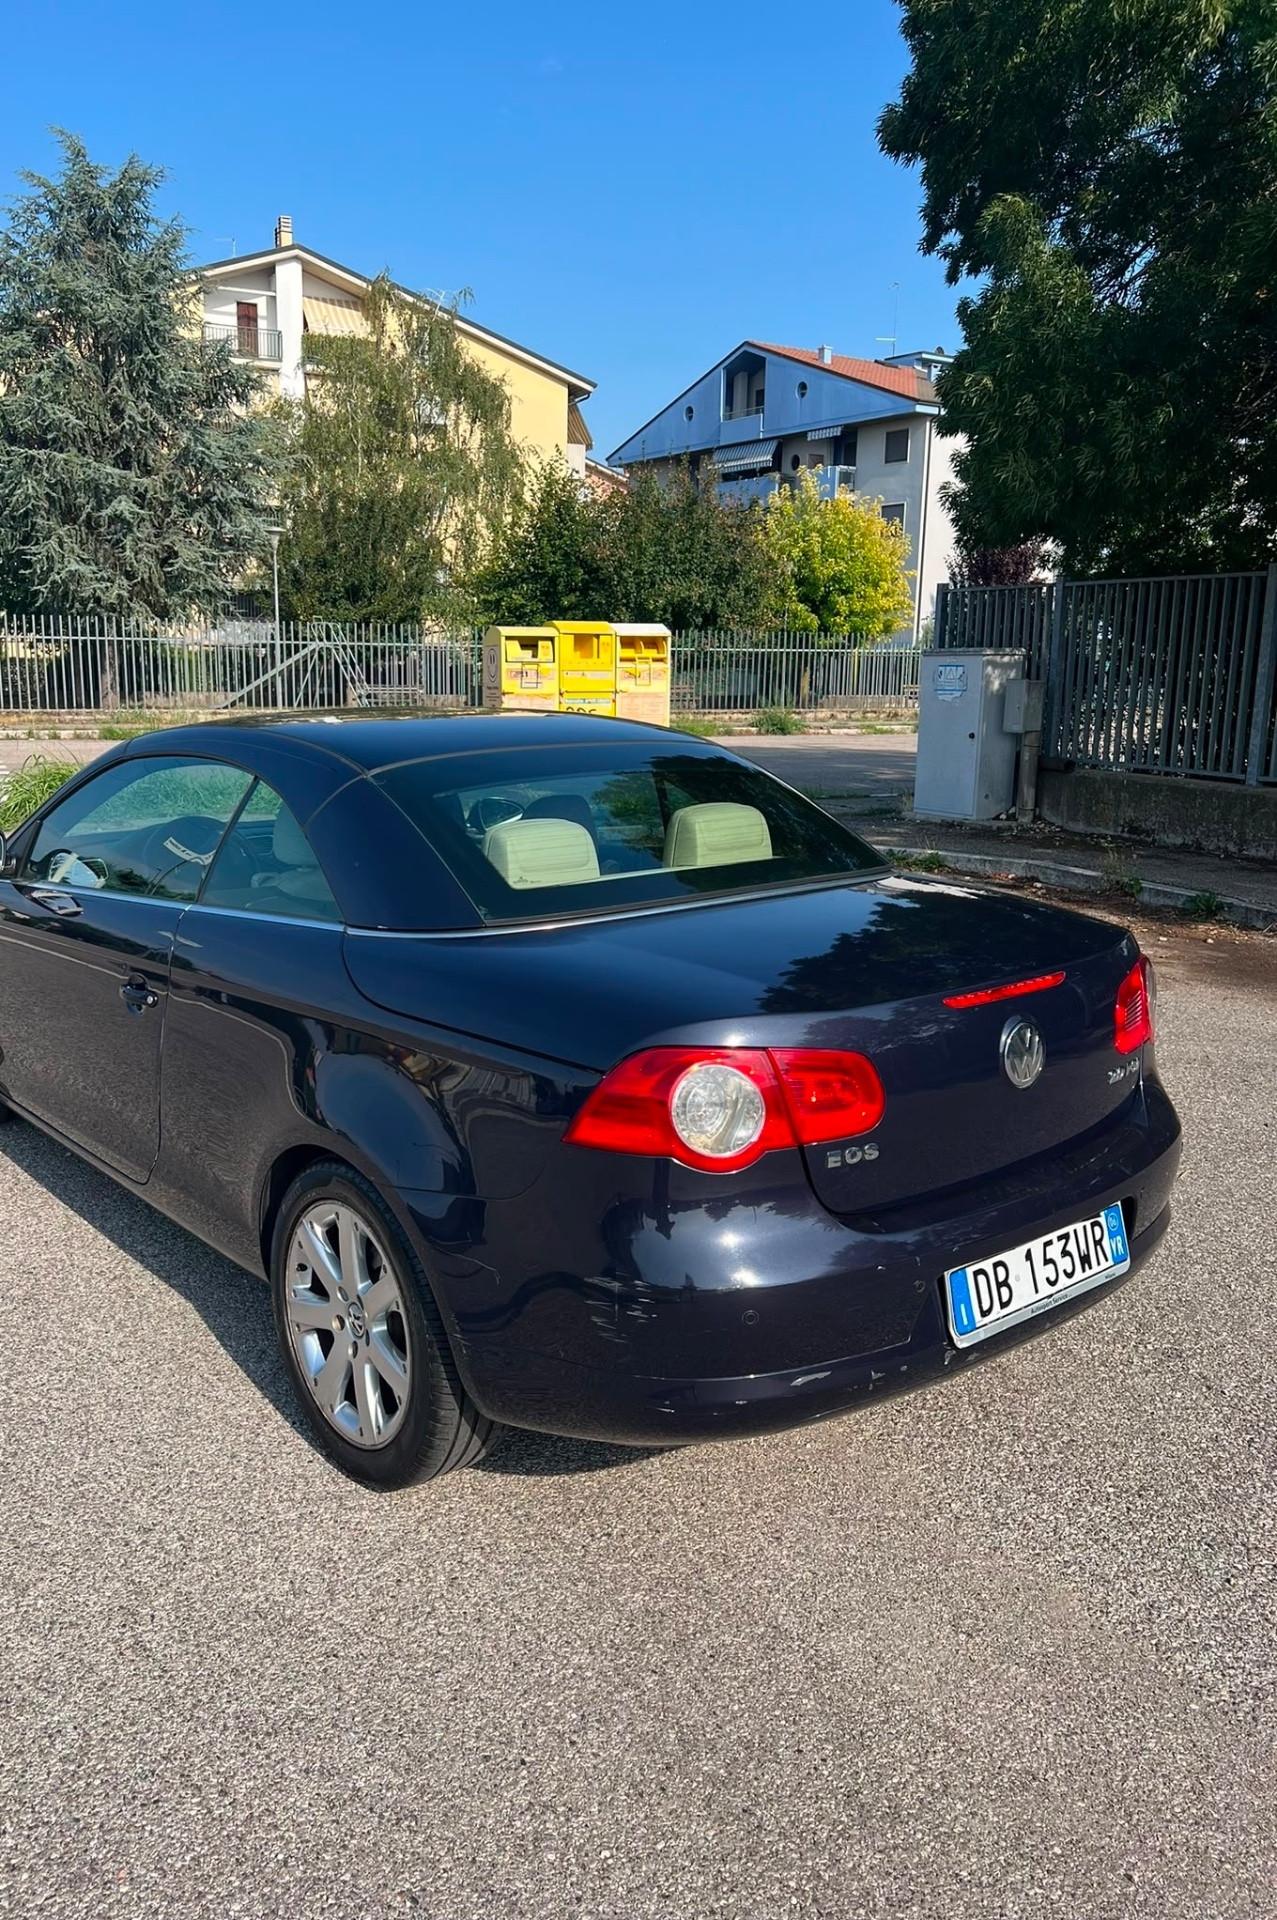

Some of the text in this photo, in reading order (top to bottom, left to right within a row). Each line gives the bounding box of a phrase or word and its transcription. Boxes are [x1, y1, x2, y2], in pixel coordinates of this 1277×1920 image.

[826, 1142, 880, 1169] EOS
[973, 1260, 1012, 1318] DB
[1025, 1220, 1108, 1294] 153WR
